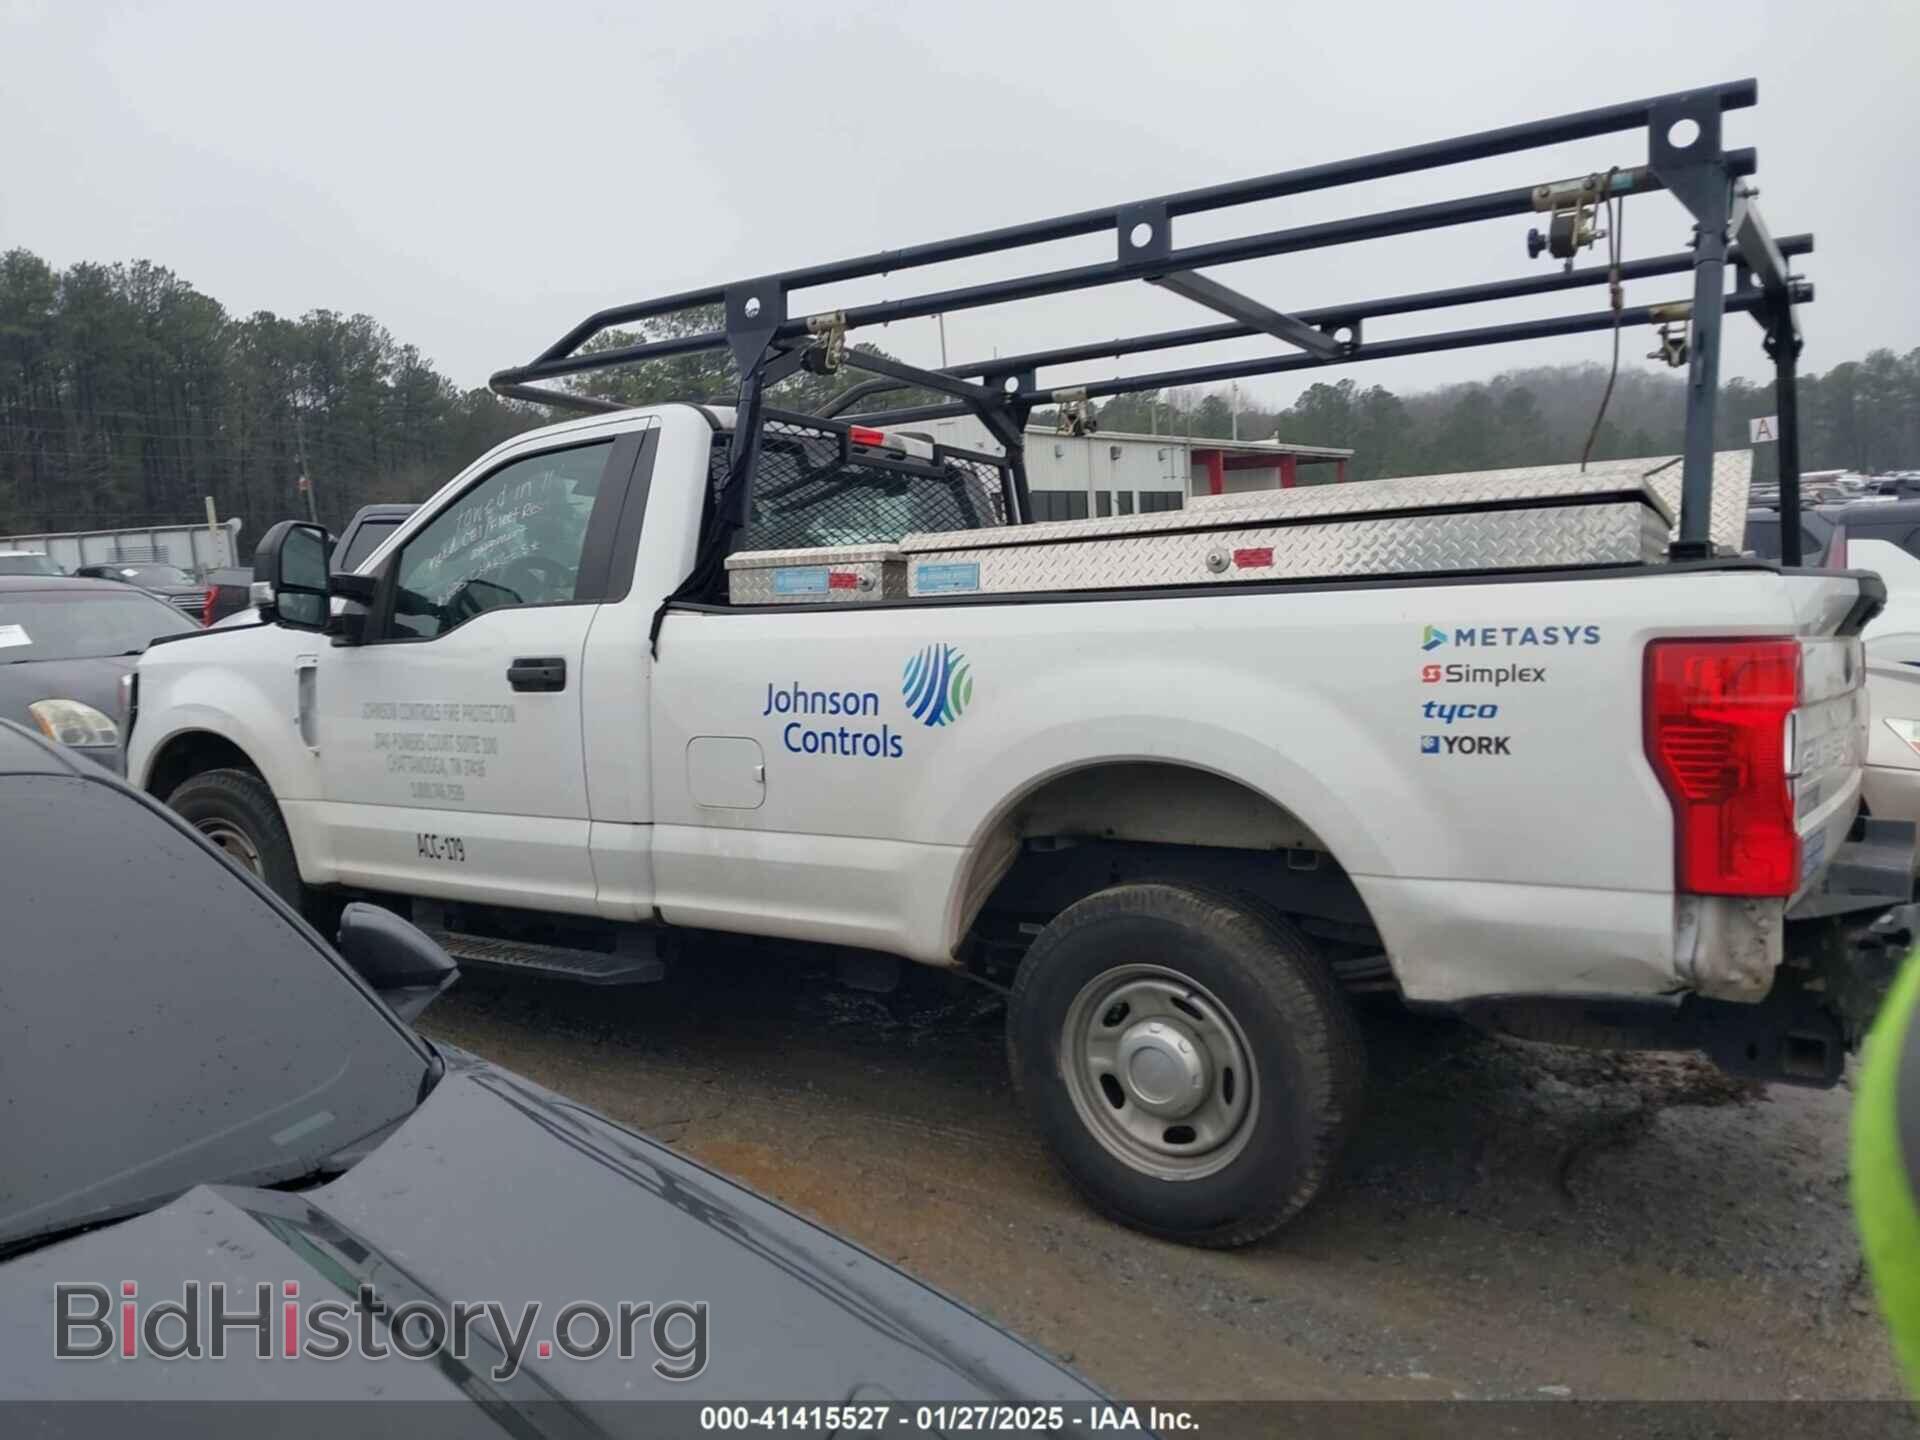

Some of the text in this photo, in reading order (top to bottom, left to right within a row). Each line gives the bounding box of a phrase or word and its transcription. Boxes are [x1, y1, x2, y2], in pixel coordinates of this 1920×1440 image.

[1755, 416, 1773, 440] A
[1454, 625, 1601, 647] METASYS
[1445, 663, 1547, 687] Simplex
[763, 681, 879, 716] Johnson
[1421, 700, 1499, 725] tyco
[784, 722, 904, 758] Controls
[1443, 735, 1512, 756] YORK
[416, 833, 466, 862] ACC-179
